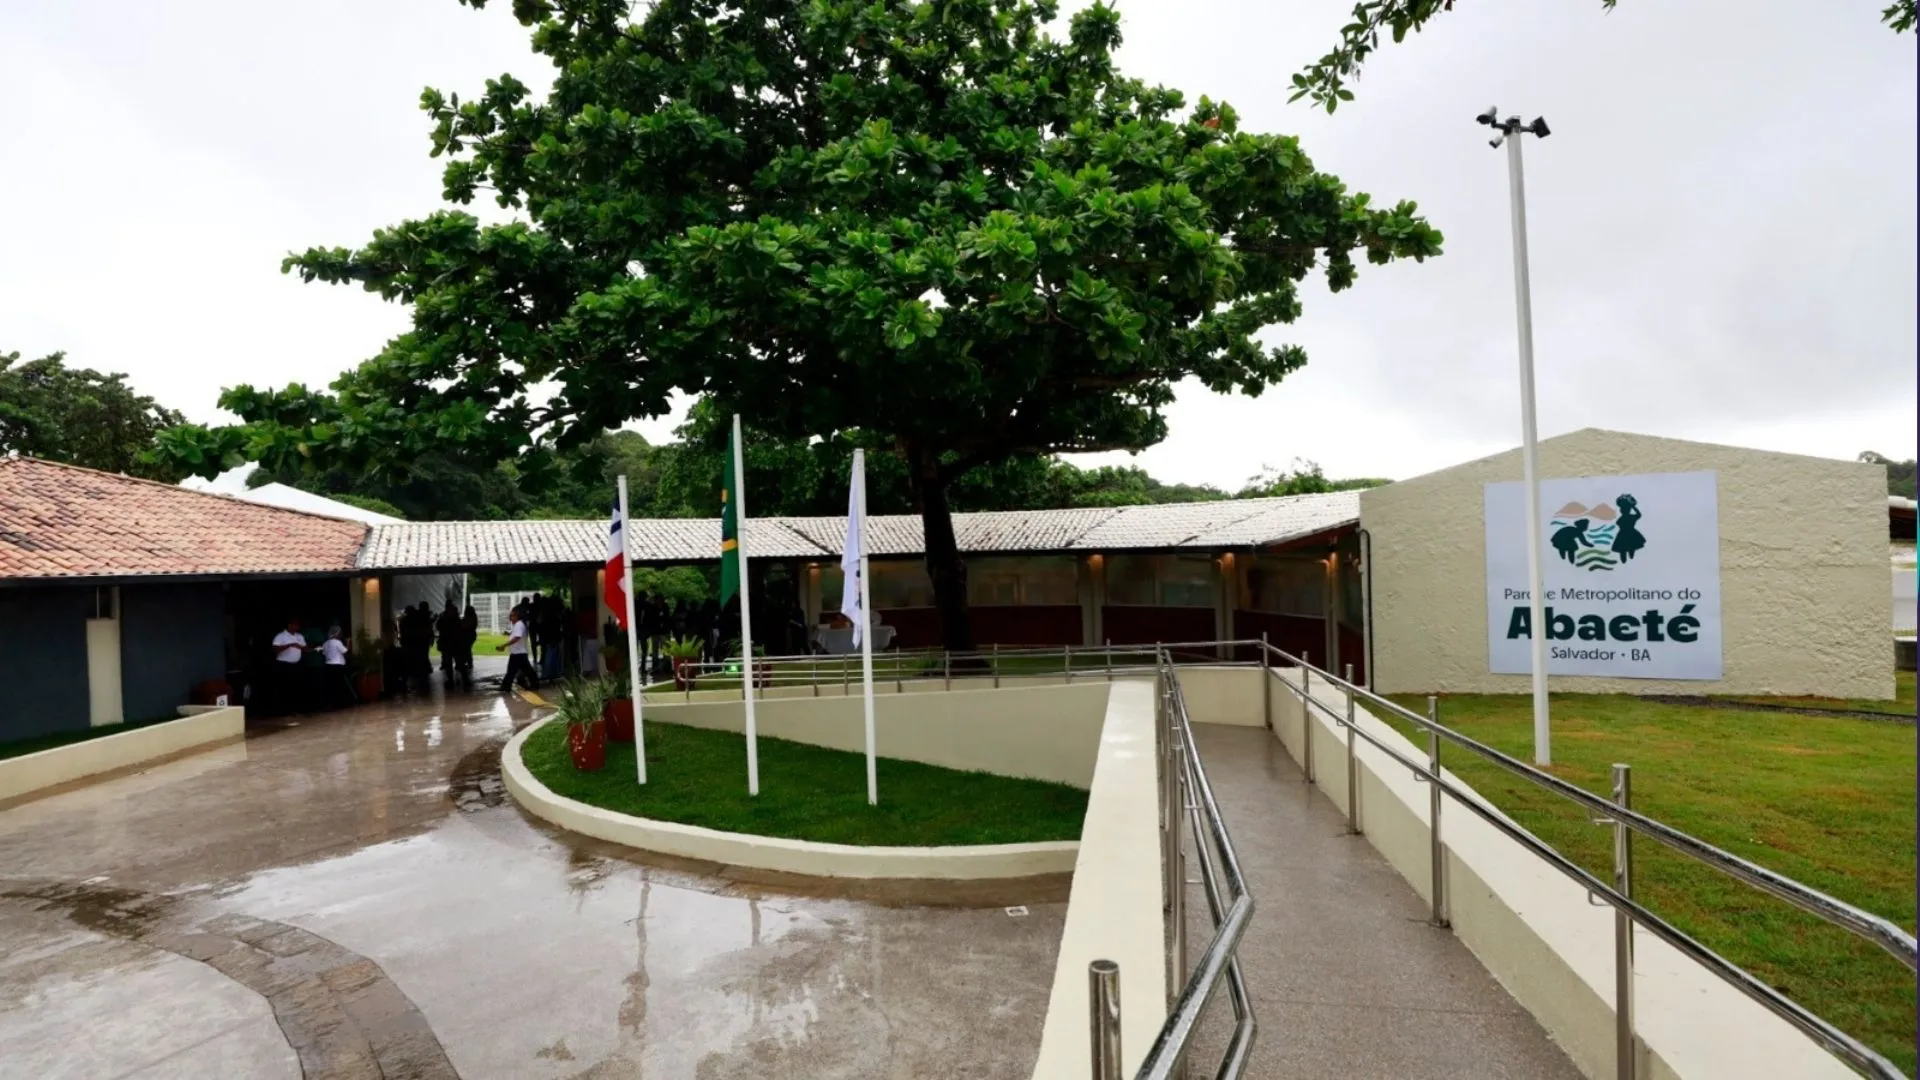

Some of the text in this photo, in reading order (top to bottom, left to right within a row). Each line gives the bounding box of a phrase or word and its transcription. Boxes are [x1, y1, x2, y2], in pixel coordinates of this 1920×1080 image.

[1504, 587, 1701, 603] Pare Metropolitano do
[1506, 604, 1701, 643] Abaeté
[1551, 646, 1651, 661] Salvador BA
